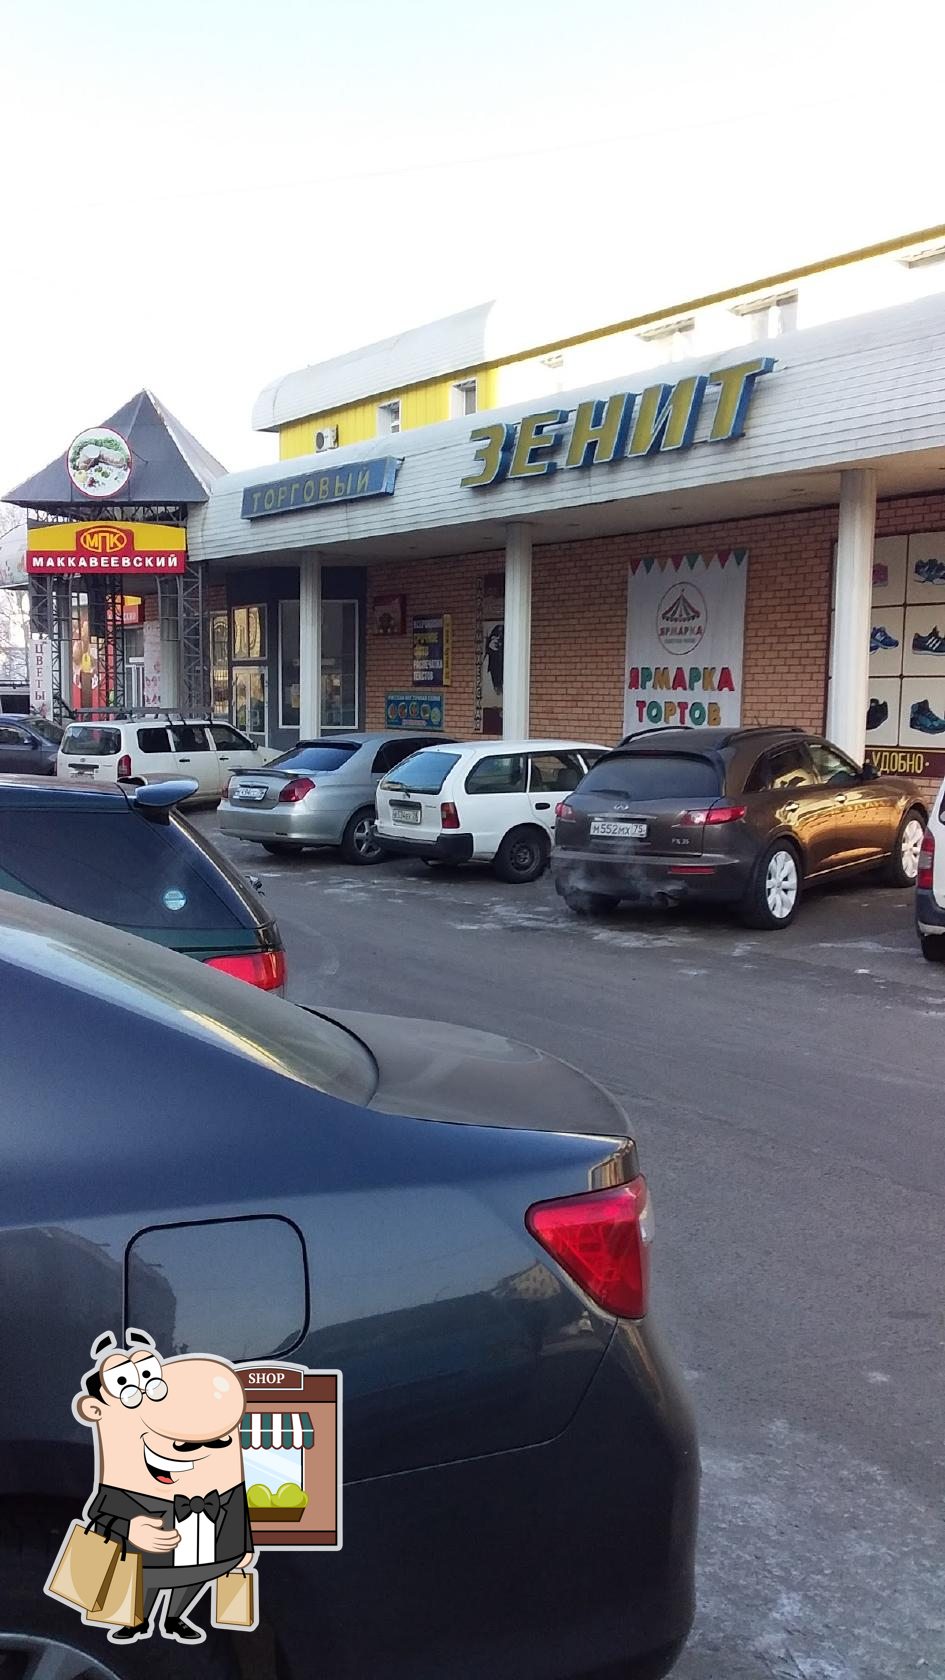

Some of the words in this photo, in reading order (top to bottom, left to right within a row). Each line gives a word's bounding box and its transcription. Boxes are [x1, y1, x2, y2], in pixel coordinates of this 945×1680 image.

[461, 357, 776, 489] ЗЕНИТ
[251, 466, 371, 513] ТОРГОВЫЙ
[84, 534, 122, 552] МПК
[32, 553, 178, 568] МАККАВЕЕВСКИЙ
[33, 644, 46, 701] ЦВЕТЫ
[628, 667, 735, 692] ЯРМАРКА
[636, 701, 721, 726] ТОРТОВ
[872, 751, 924, 774] УДОБНО
